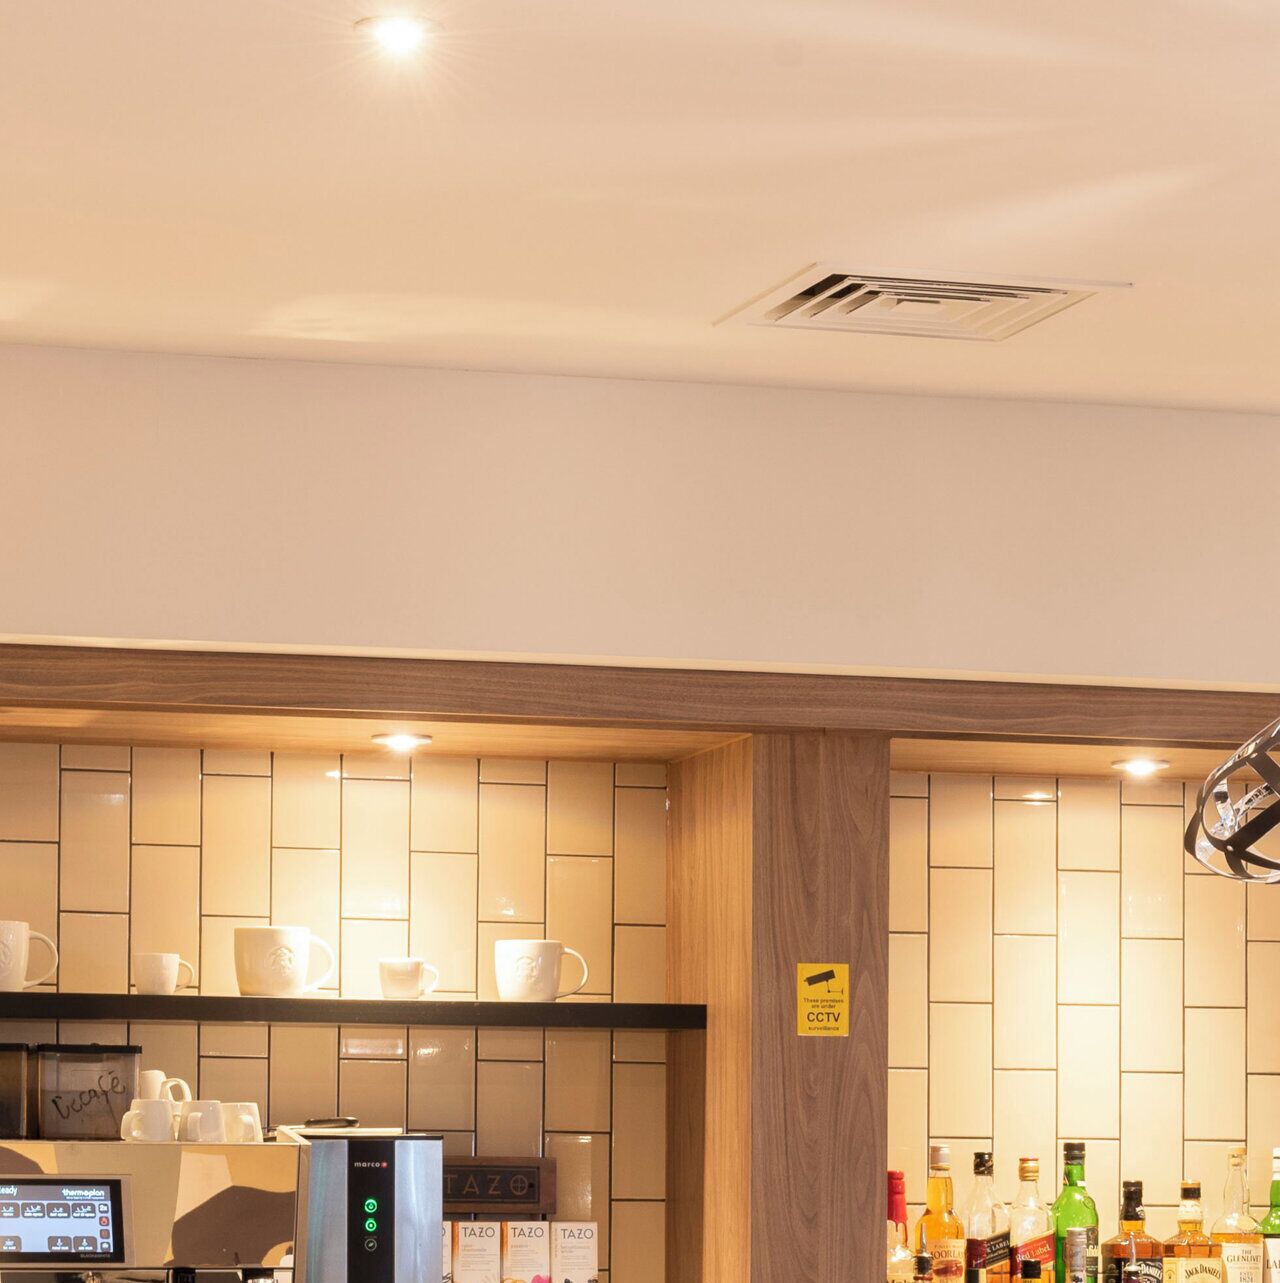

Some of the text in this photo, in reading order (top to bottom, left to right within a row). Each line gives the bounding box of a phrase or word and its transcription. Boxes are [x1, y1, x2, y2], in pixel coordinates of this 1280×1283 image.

[806, 1012, 841, 1023] CCTV
[444, 1174, 529, 1196] TAZO
[462, 1227, 496, 1238] TAZO
[511, 1227, 545, 1238] TAZO
[561, 1228, 594, 1239] TAZO
[1031, 1242, 1052, 1257] Label
